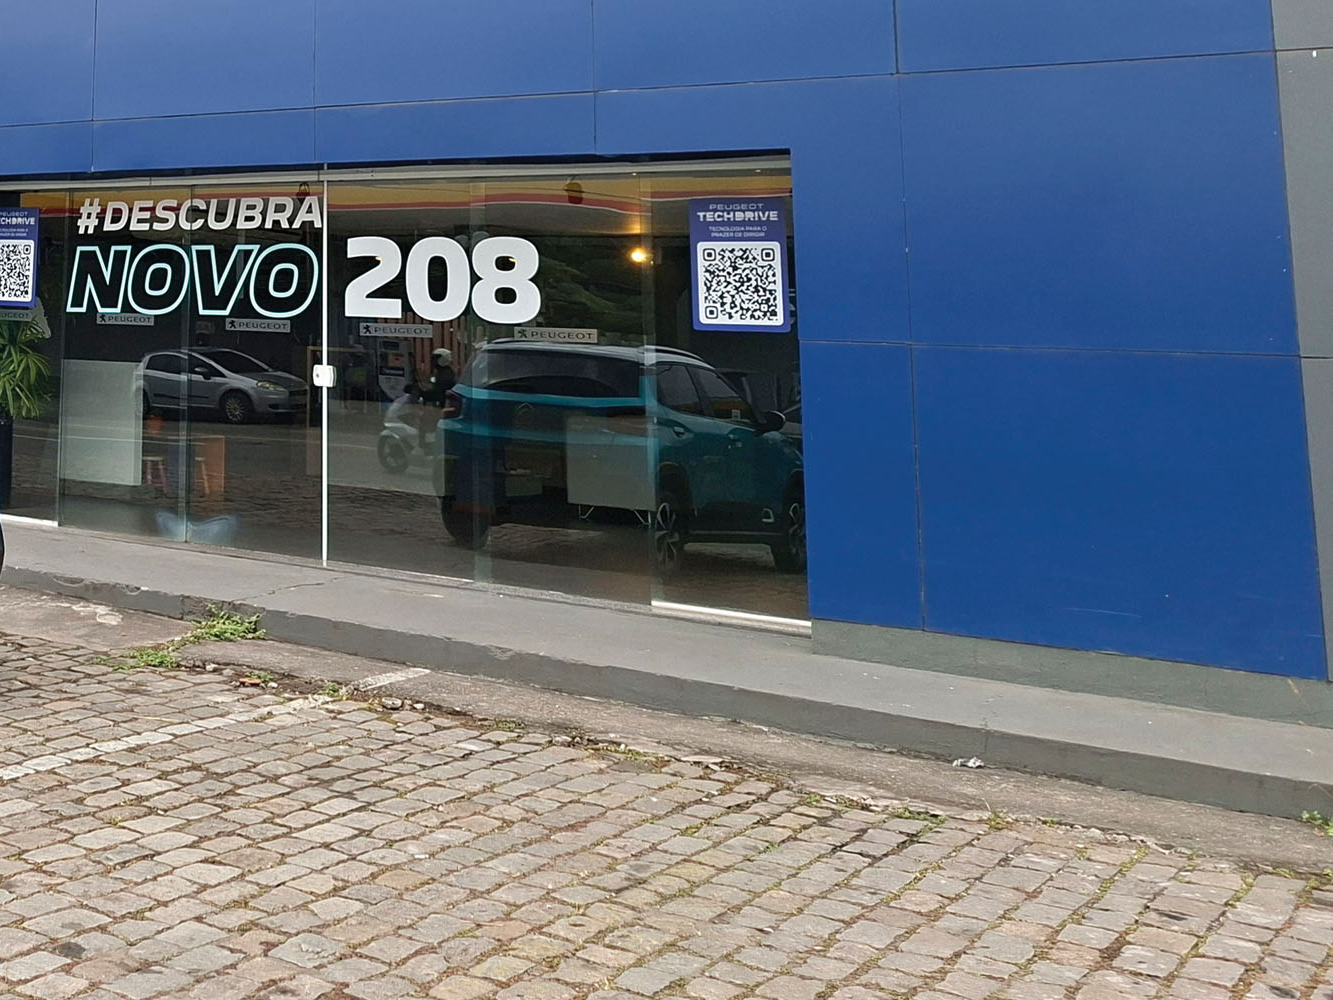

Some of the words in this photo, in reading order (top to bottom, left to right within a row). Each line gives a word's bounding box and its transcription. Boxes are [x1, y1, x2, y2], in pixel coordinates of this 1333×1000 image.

[77, 196, 323, 234] #DESCUBRA
[696, 211, 778, 221] TECHDRIVE
[67, 243, 319, 317] NOVO
[343, 236, 542, 324] 208
[108, 315, 152, 323] PEUGEOT
[239, 322, 288, 330] PEUGEOT
[374, 327, 430, 335] PEUGEOT
[530, 331, 593, 340] PEUGEOT
